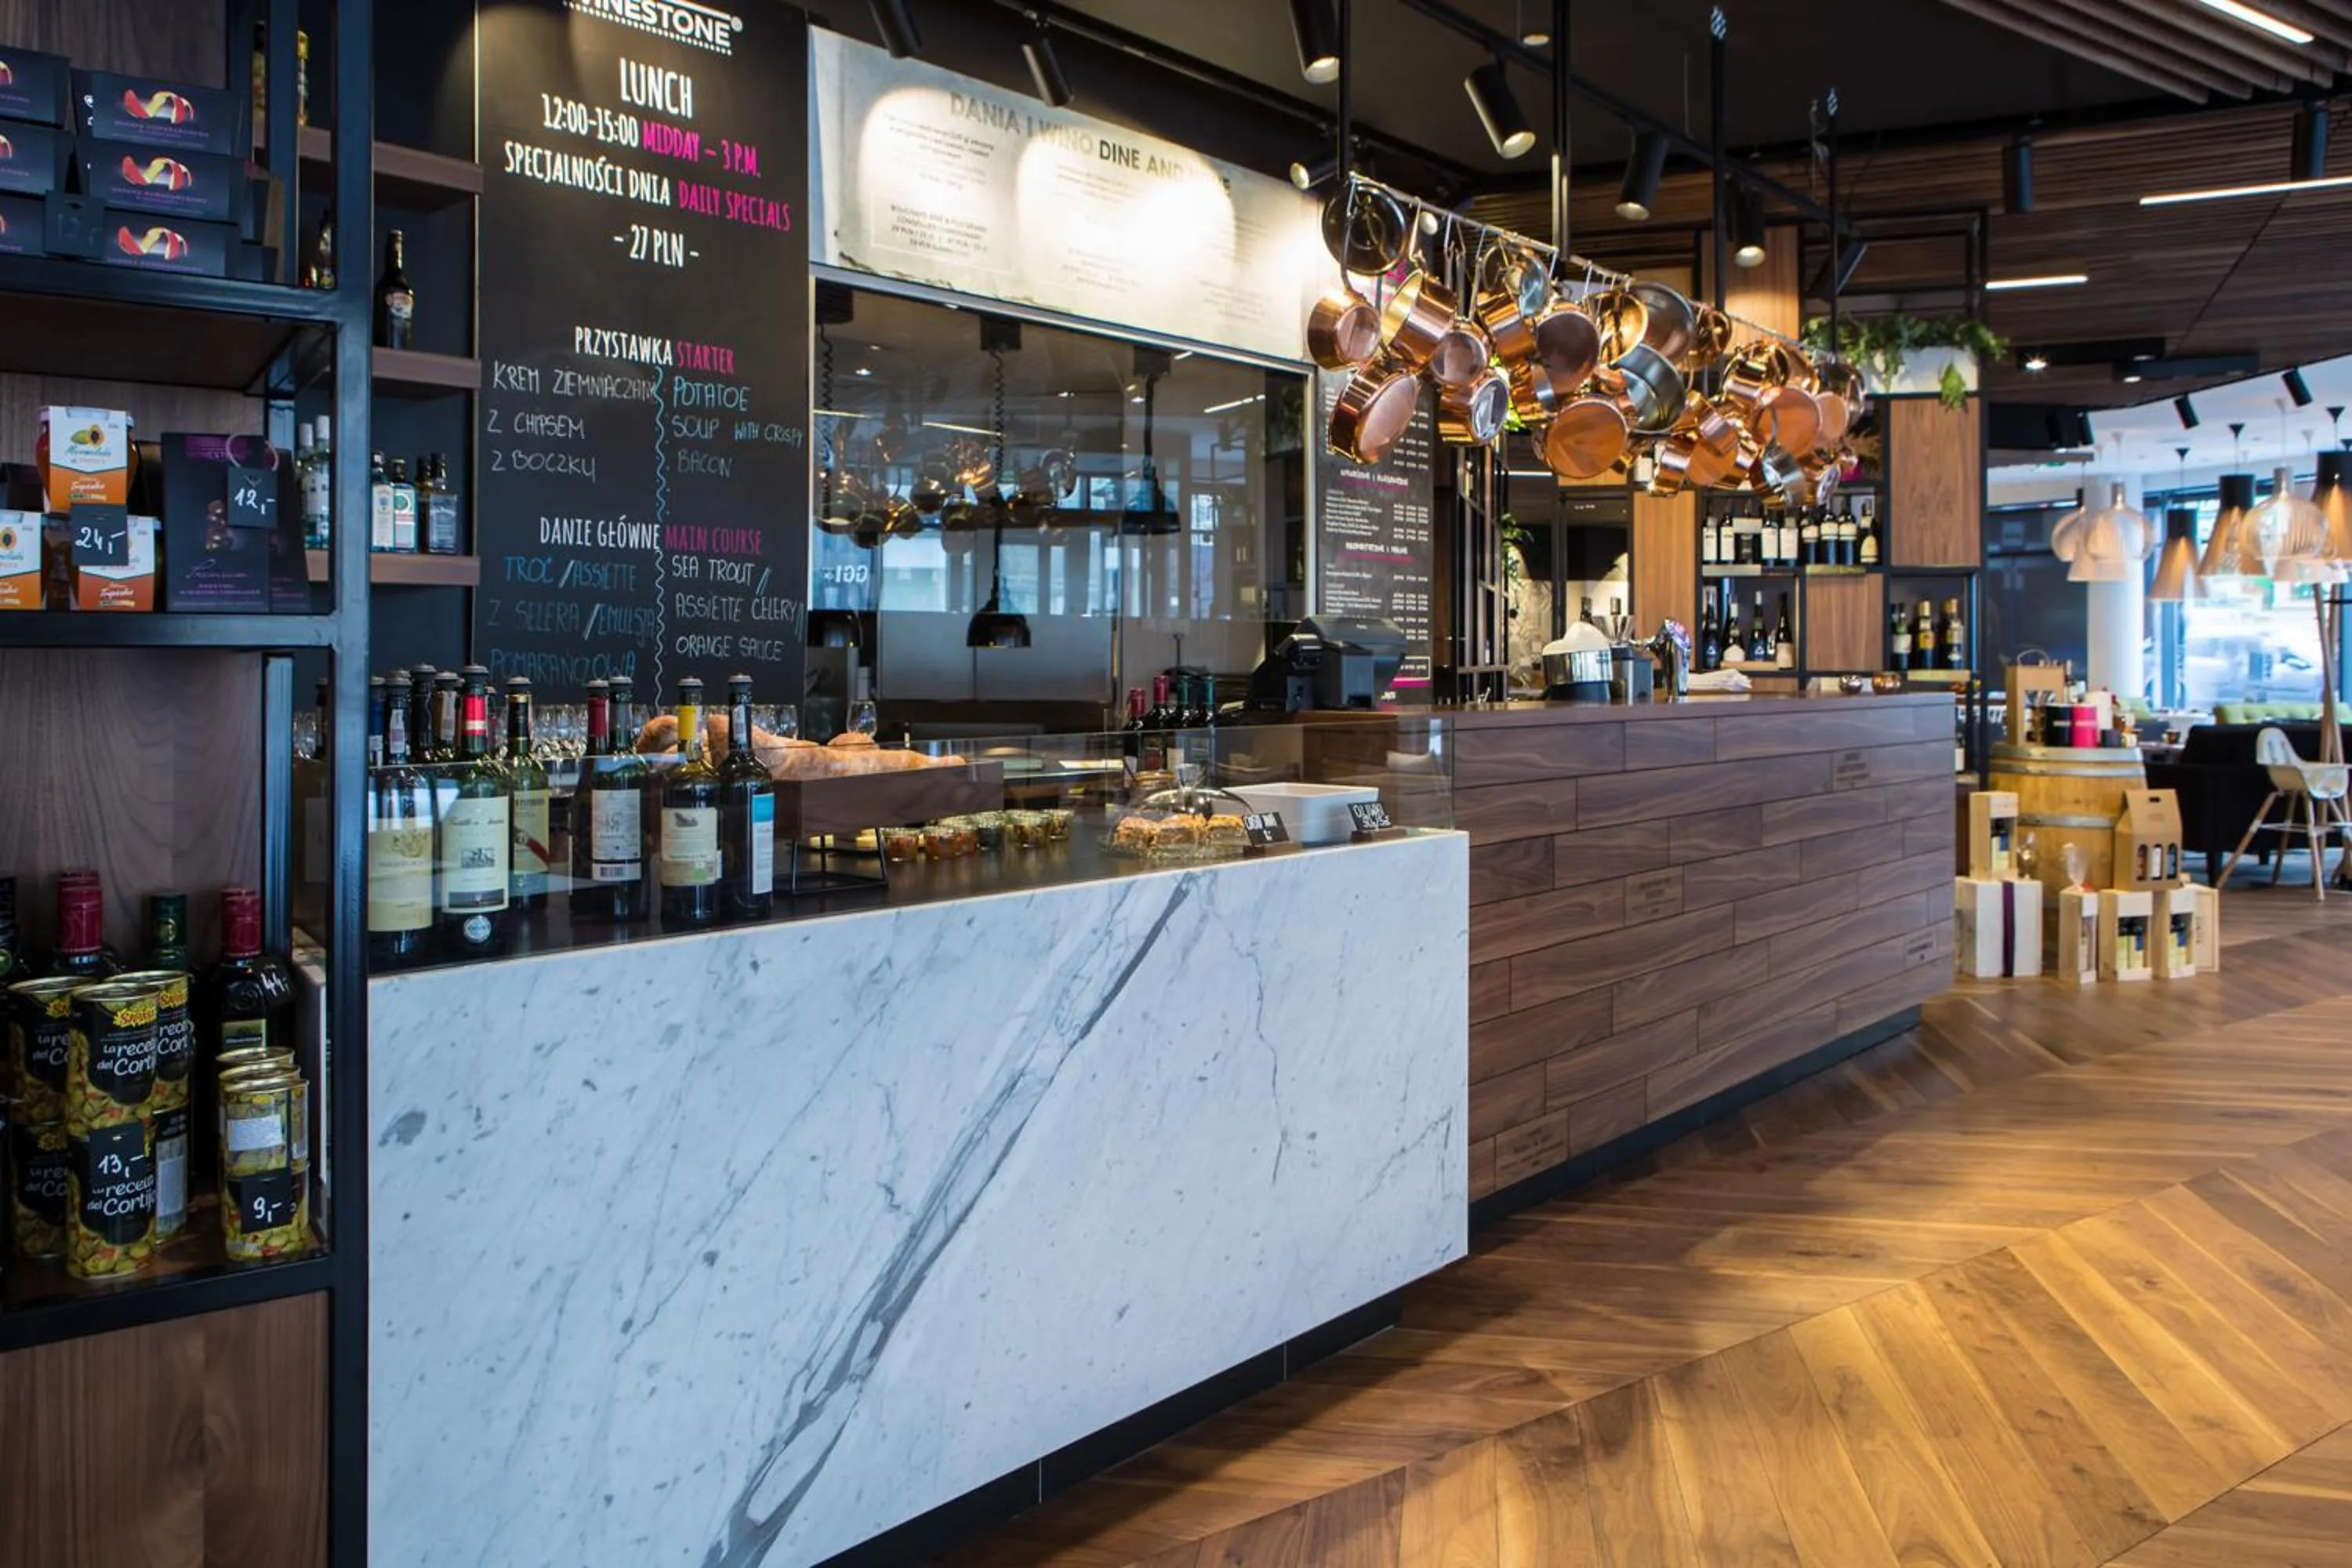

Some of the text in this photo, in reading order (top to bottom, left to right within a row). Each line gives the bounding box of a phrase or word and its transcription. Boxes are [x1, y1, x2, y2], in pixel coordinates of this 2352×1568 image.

[583, 0, 731, 48] NESTONE
[619, 58, 692, 118] LUNCH
[643, 121, 700, 162] MIDDAY
[721, 139, 731, 171] 3
[735, 143, 762, 180] P.M.
[950, 92, 1021, 134] DANIA
[1099, 139, 1140, 170] DINE
[504, 140, 791, 232] SPECJALNOŚCI DNIA DAILY SPECIALS
[630, 224, 648, 261] 27
[654, 229, 684, 269] PLN
[575, 325, 735, 374] PRZYSTAWKA STARTER
[493, 360, 540, 394] KREM
[673, 376, 751, 412] POTATOE
[672, 416, 720, 440] SOUP
[678, 448, 733, 477] BACON
[540, 514, 762, 556] DANIE GŁÓWNE MAIN COURSE
[672, 555, 699, 578] SEA
[709, 559, 755, 586] TROUT
[675, 593, 744, 622] ASSIETTE
[676, 634, 784, 662] ORANGE SAUCE
